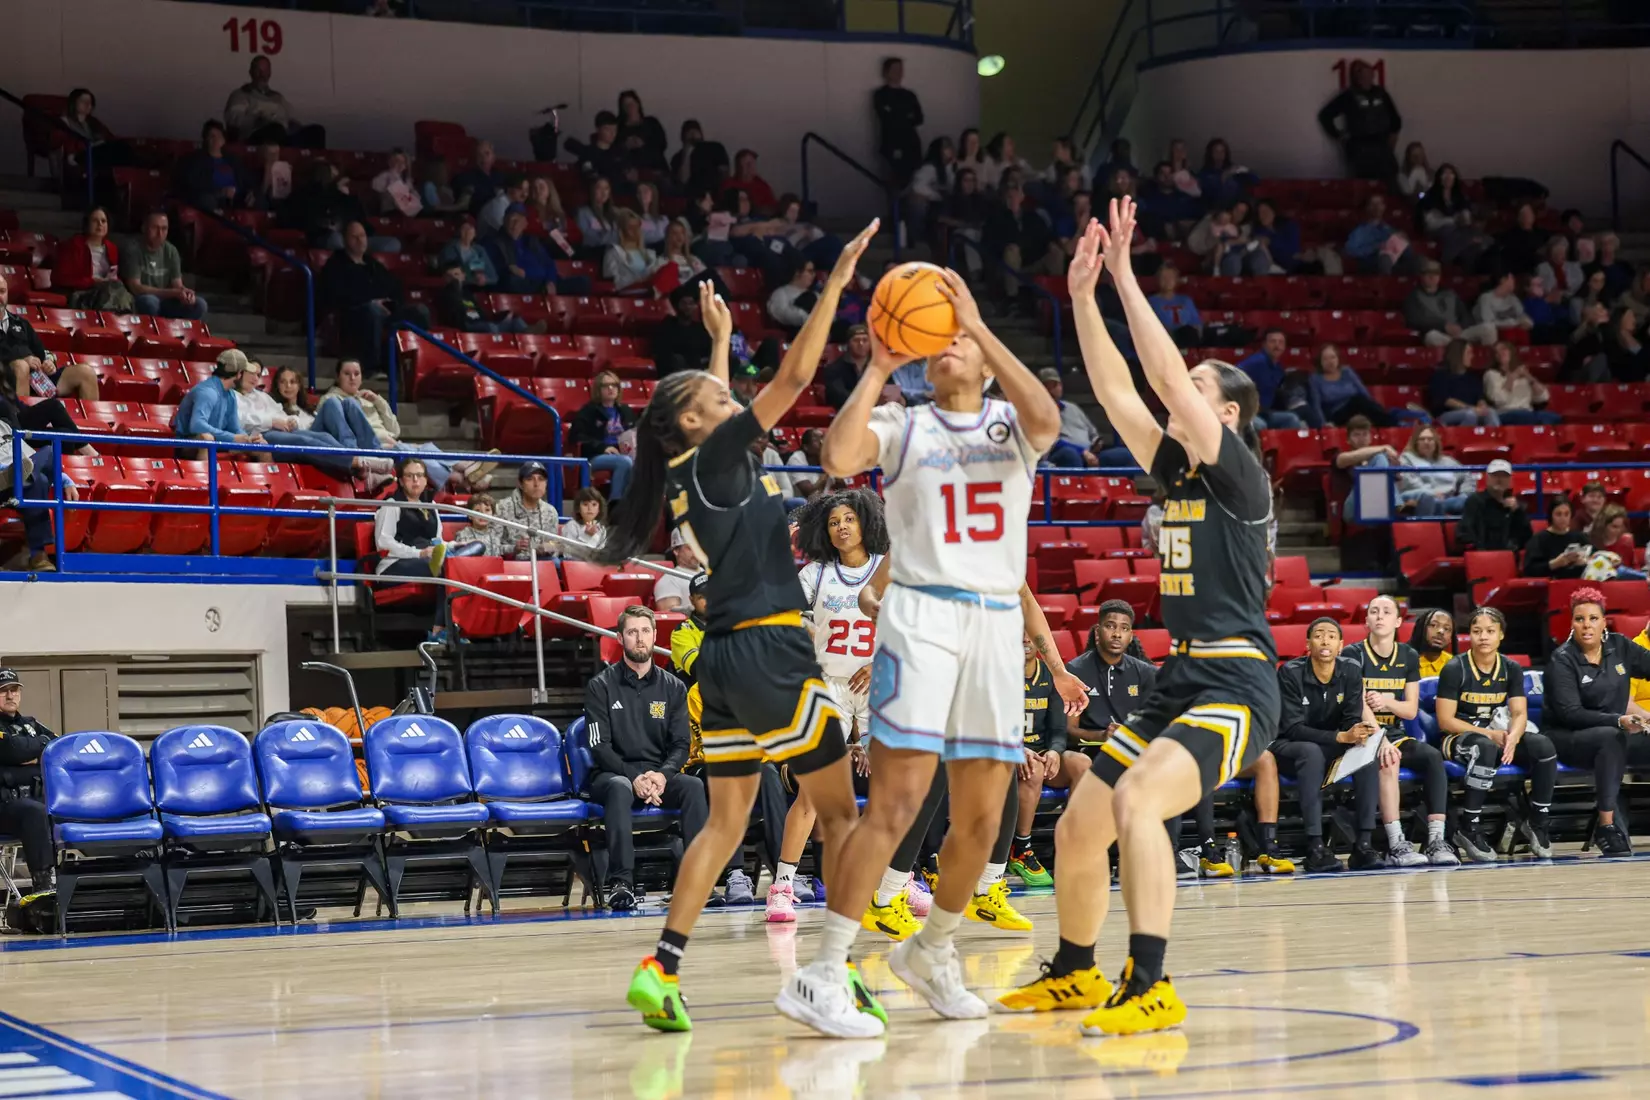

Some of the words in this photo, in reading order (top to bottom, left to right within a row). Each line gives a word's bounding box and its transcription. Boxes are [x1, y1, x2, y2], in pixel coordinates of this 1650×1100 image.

[222, 17, 283, 56] 119
[1331, 59, 1386, 90] 11
[940, 481, 1005, 543] 15
[825, 619, 877, 657] 23
